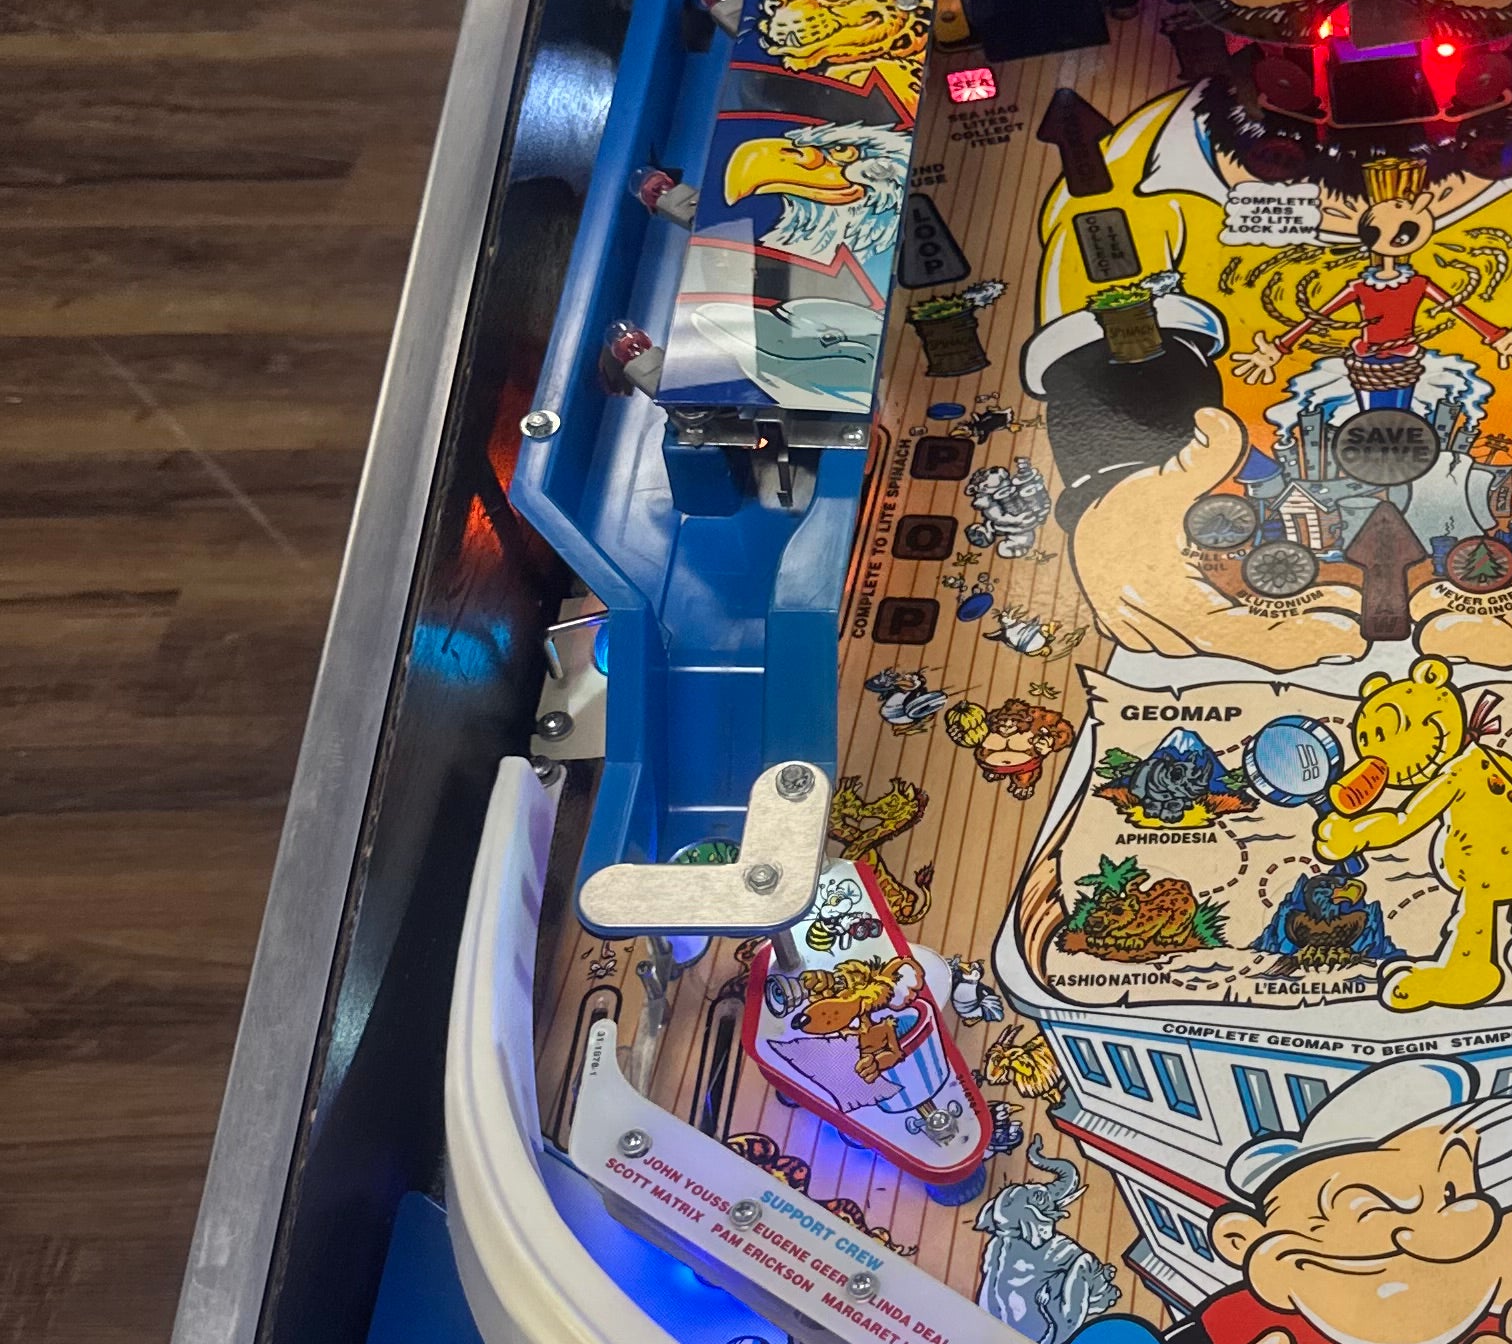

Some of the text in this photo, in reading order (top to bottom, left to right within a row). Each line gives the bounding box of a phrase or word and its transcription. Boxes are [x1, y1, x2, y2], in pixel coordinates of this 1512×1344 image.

[1229, 197, 1317, 206] COMPLETE
[1251, 207, 1294, 215] JABS
[1240, 215, 1303, 225] TO LITE
[1228, 225, 1314, 234] LOCK JAW
[1346, 426, 1425, 447] SAVE
[852, 439, 912, 639] COMPLETE TO LITE SPINACH
[1235, 589, 1324, 610] BLUTONIUM
[1435, 583, 1486, 605] NEVER
[1247, 605, 1300, 619] WASTE
[1120, 705, 1242, 722] GEOMAP
[1115, 832, 1218, 845] APHRODESIA
[1048, 972, 1172, 987] FASHIONATION
[1254, 982, 1366, 995] L'EAGLELAND
[1162, 1023, 1260, 1044] COMPLETE
[1267, 1034, 1344, 1052] GEOMAP
[1351, 1044, 1376, 1056] TO
[1382, 1041, 1438, 1057] BEGIN
[605, 1158, 650, 1190] SCOTT
[650, 1186, 705, 1224] MATRIX
[710, 1223, 742, 1248] PAM
[742, 1242, 816, 1293] ERICKSON
[759, 1190, 885, 1271] SUPPORT CREW
[643, 1156, 682, 1184] JOHN
[753, 1223, 811, 1263] EUGENE
[810, 1258, 849, 1288] GEER
[867, 1294, 910, 1328] LINDA
